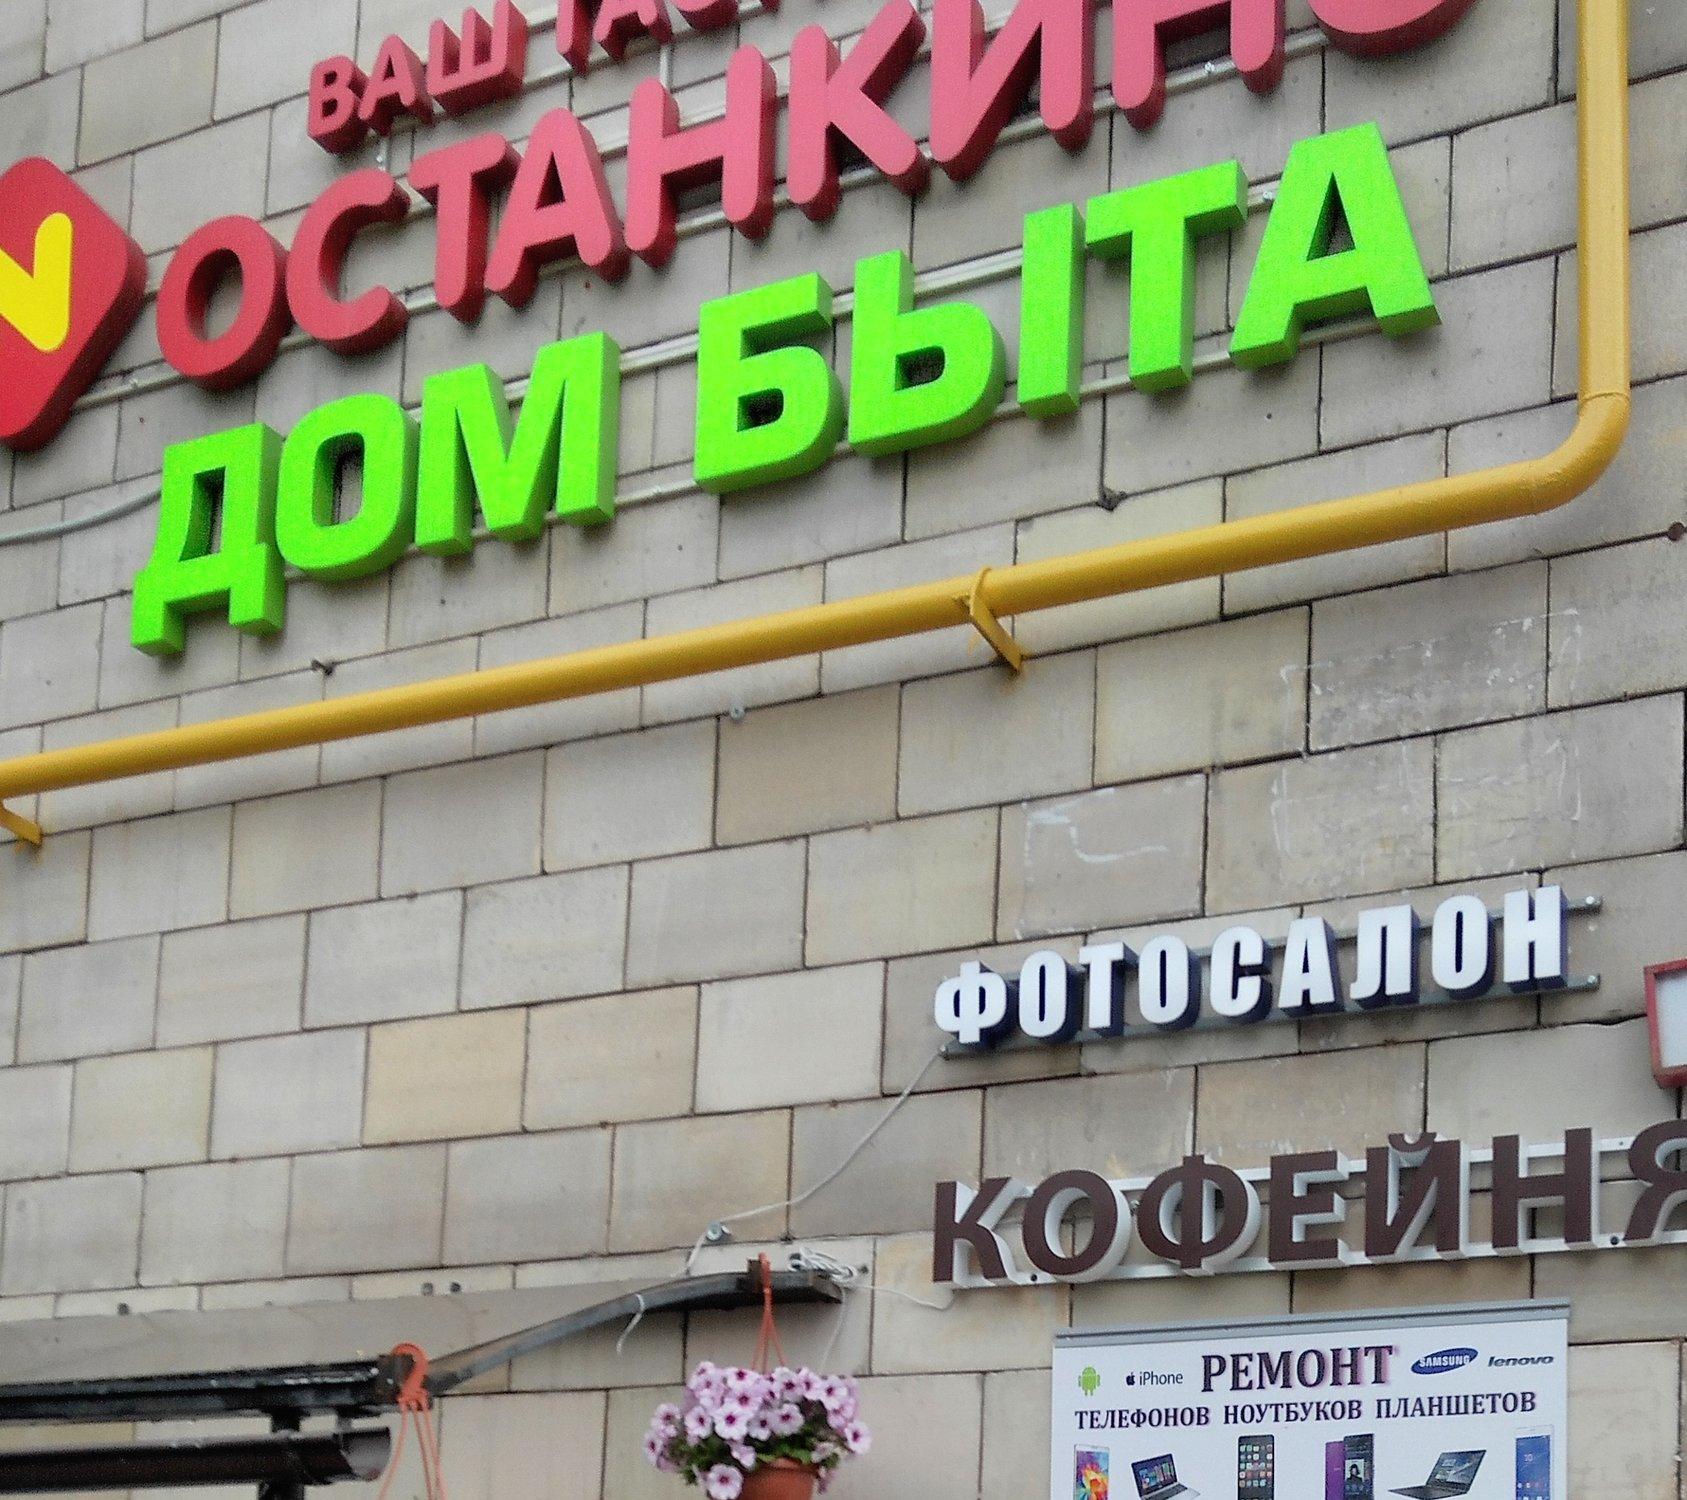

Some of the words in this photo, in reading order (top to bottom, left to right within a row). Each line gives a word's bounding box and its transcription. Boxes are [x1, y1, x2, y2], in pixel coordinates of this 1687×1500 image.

[309, 0, 527, 153] ВАШ
[156, 0, 1472, 390] ОСТАНКИН
[131, 332, 620, 656] ДОМ
[694, 122, 1441, 493] БЫТА
[933, 885, 1569, 1046] ФОТОСАЛОН
[932, 1118, 1687, 1287] КОФЕЙНЯ
[1074, 1406, 1210, 1430] ТЕЛЕФОНОВ
[1223, 1399, 1363, 1426] НОУТБУКОВ
[1375, 1391, 1537, 1420] ПЛАНШЕТОВ
[1138, 1371, 1184, 1387] iPhone
[1200, 1345, 1394, 1393] РЕМОНТ
[1417, 1353, 1471, 1368] SAMSUNG
[1487, 1355, 1555, 1368] lenovo
